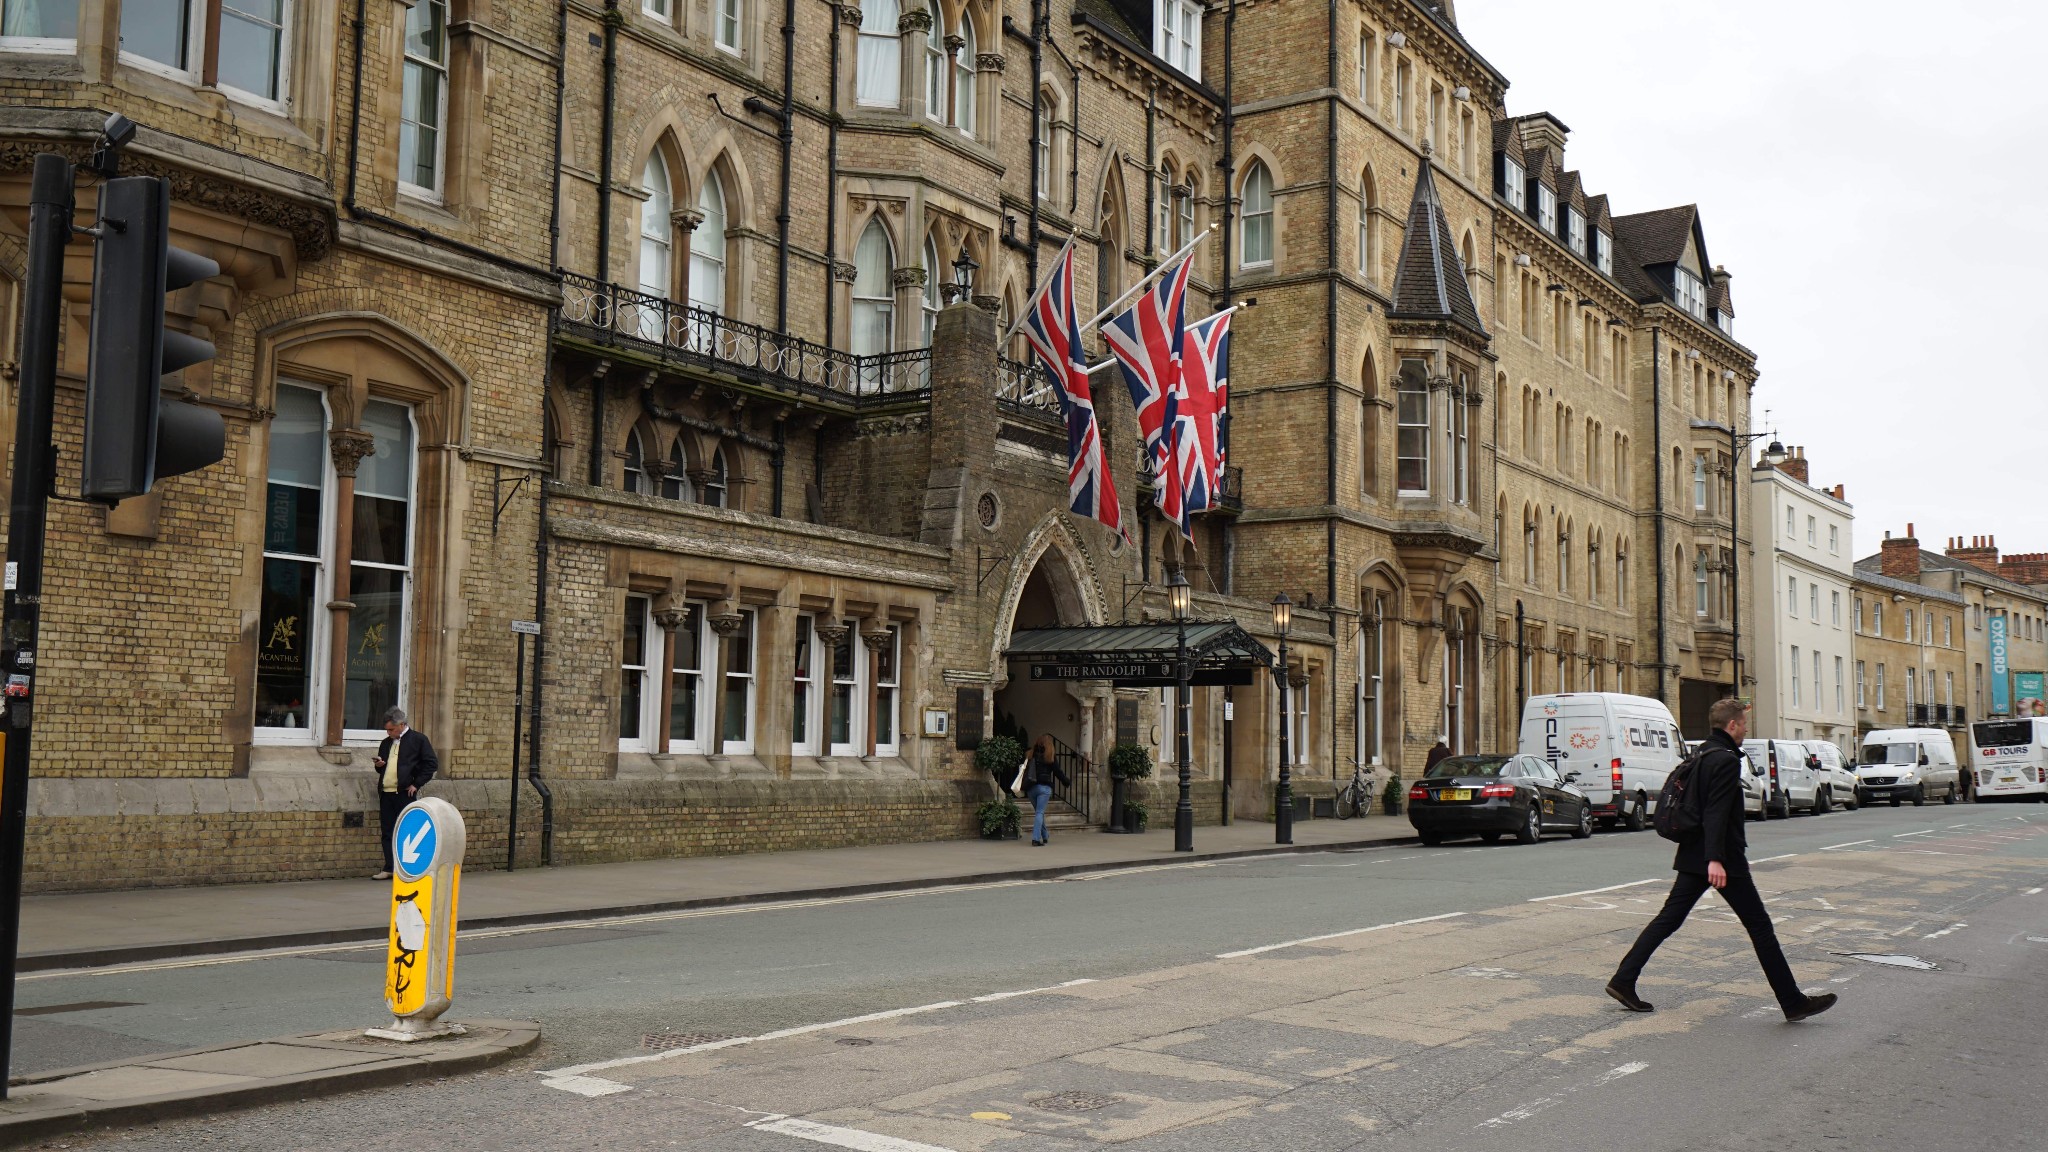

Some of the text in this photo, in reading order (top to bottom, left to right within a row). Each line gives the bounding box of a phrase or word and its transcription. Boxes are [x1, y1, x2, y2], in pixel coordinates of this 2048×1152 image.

[1991, 619, 2006, 674] OXFORD
[1056, 665, 1146, 677] THE RANDOLPH
[1982, 746, 2028, 756] GB TOURS
